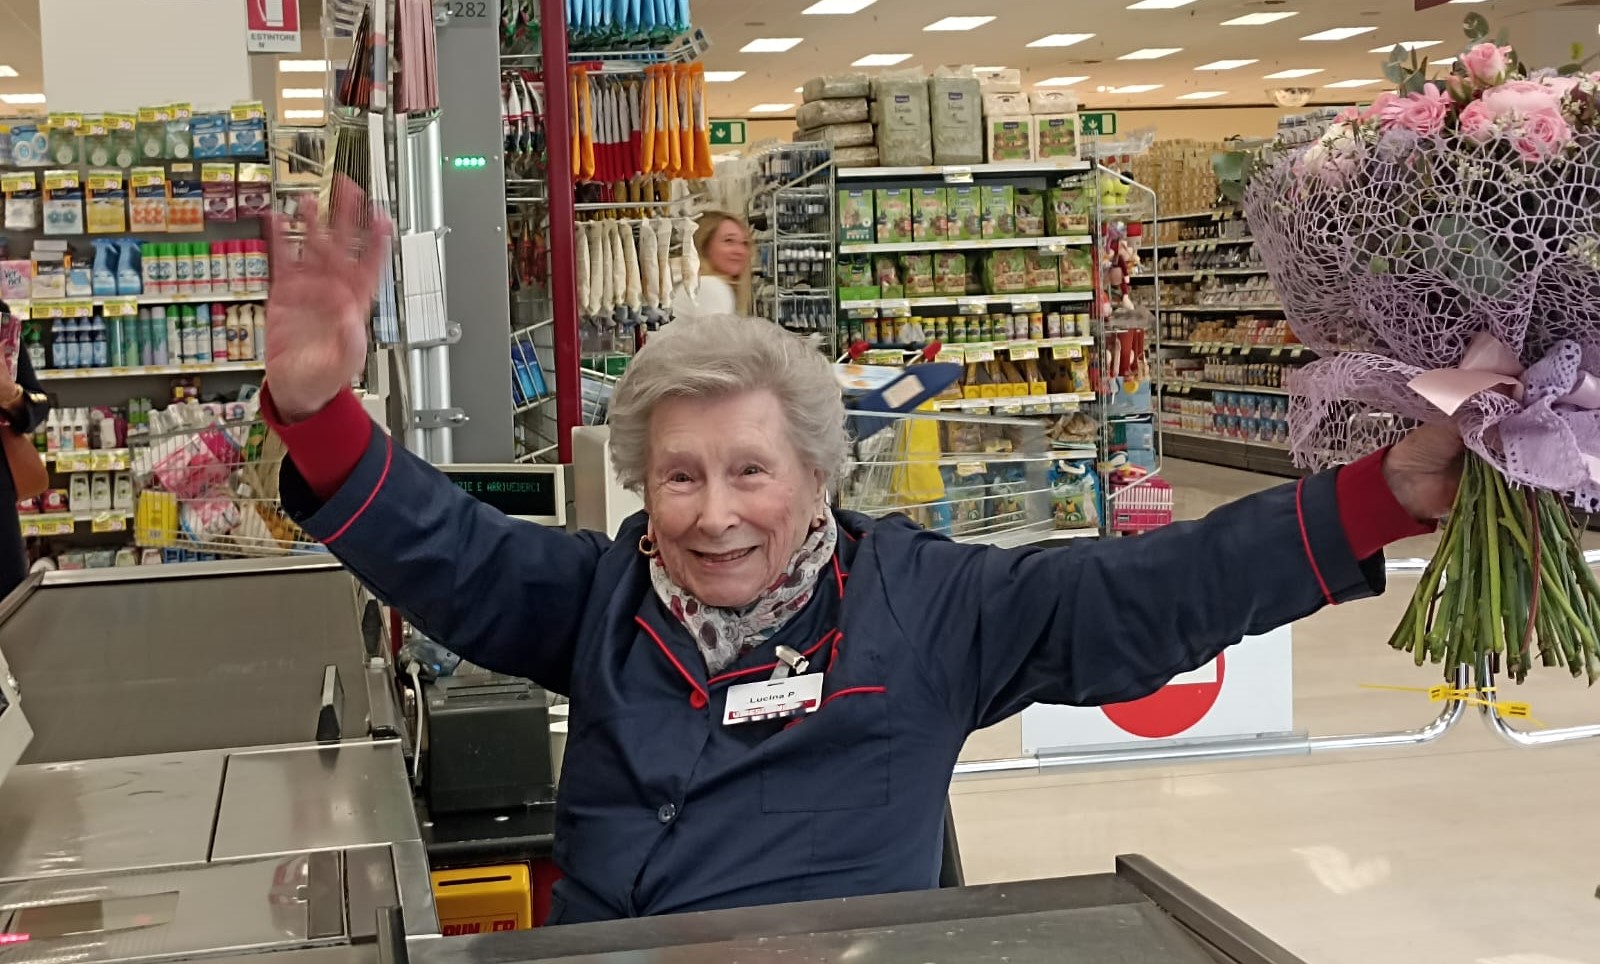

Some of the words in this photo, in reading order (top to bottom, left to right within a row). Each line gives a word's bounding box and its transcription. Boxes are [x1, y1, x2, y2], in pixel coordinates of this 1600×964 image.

[445, 2, 487, 17] 1282
[251, 32, 296, 42] ESTINTORE
[749, 694, 785, 703] Lucina
